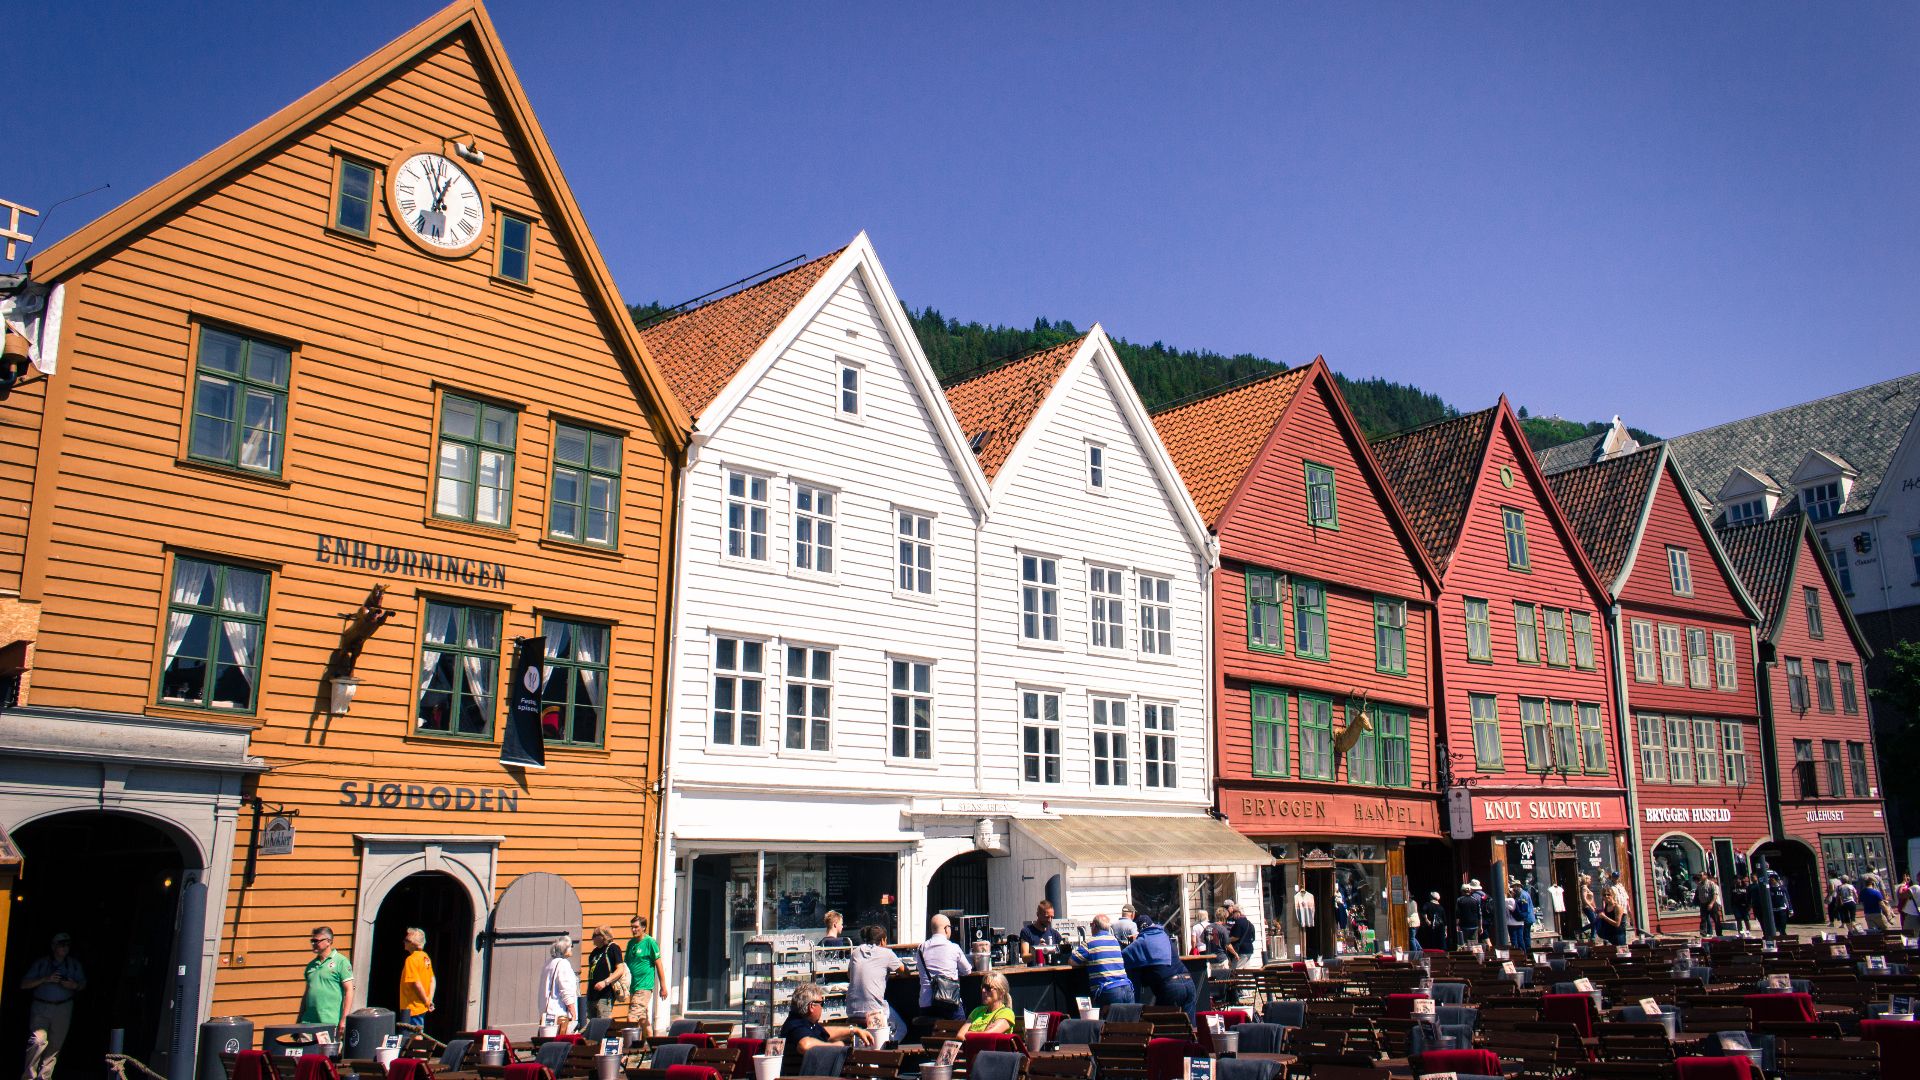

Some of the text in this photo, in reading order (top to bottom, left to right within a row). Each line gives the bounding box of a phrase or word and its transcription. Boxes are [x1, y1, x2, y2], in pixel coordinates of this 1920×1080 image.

[315, 534, 506, 590] ENHJØRNINGEN
[339, 781, 518, 813] SJØBODEN
[1241, 797, 1417, 825] BRYGGEN HANDEL
[1484, 801, 1601, 820] KNUT SKURTVEIT
[1645, 807, 1731, 823] BRYGGEN HUSFLID
[1805, 810, 1844, 822] JULEHUSET
